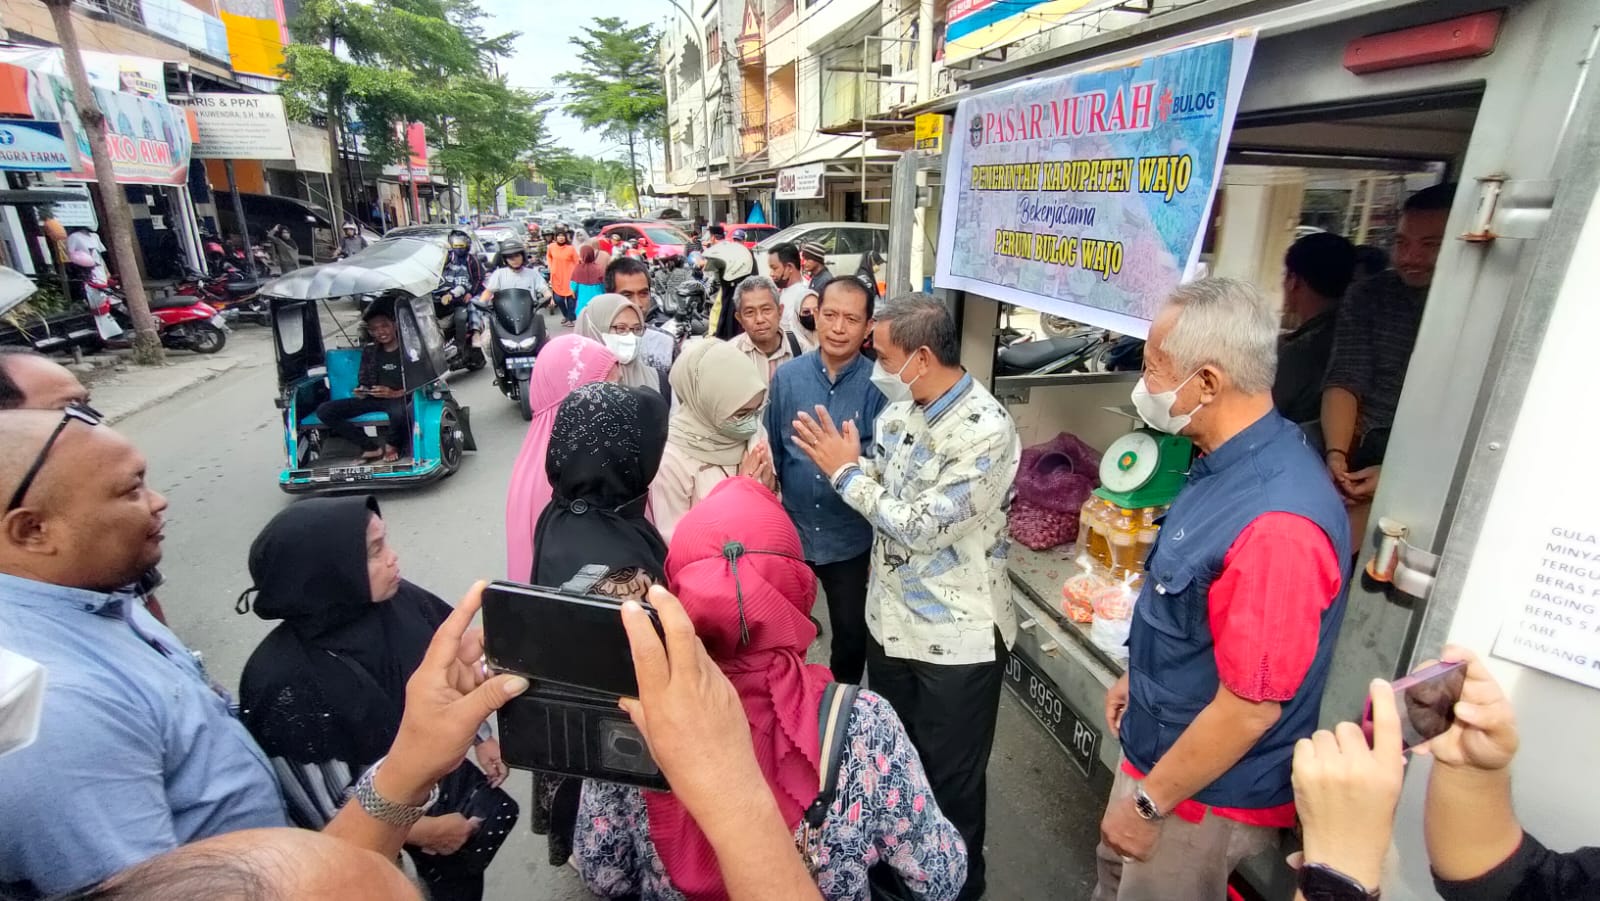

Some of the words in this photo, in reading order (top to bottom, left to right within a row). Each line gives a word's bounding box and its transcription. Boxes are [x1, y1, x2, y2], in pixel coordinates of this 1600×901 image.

[219, 98, 228, 107] &
[230, 98, 259, 108] PPAT
[985, 103, 1044, 145] PASAR
[1049, 83, 1158, 139] MURAH
[1172, 91, 1216, 114] BULOG
[30, 152, 67, 163] FARMA
[970, 162, 1041, 191] PEMERINTAH
[1042, 158, 1135, 193] KABUPATEN
[1137, 154, 1193, 202] WAJO
[1020, 196, 1096, 228] Bekerjasama
[994, 228, 1033, 260] PERUM
[1034, 232, 1078, 266] BULOG
[1081, 238, 1124, 280] WAJO
[1551, 527, 1596, 544] GULA
[1535, 573, 1585, 595] BERAS
[1530, 588, 1595, 614] DAGING
[1525, 603, 1573, 626] BERAS
[1030, 675, 1062, 723] 8959
[1073, 720, 1093, 757] RC
